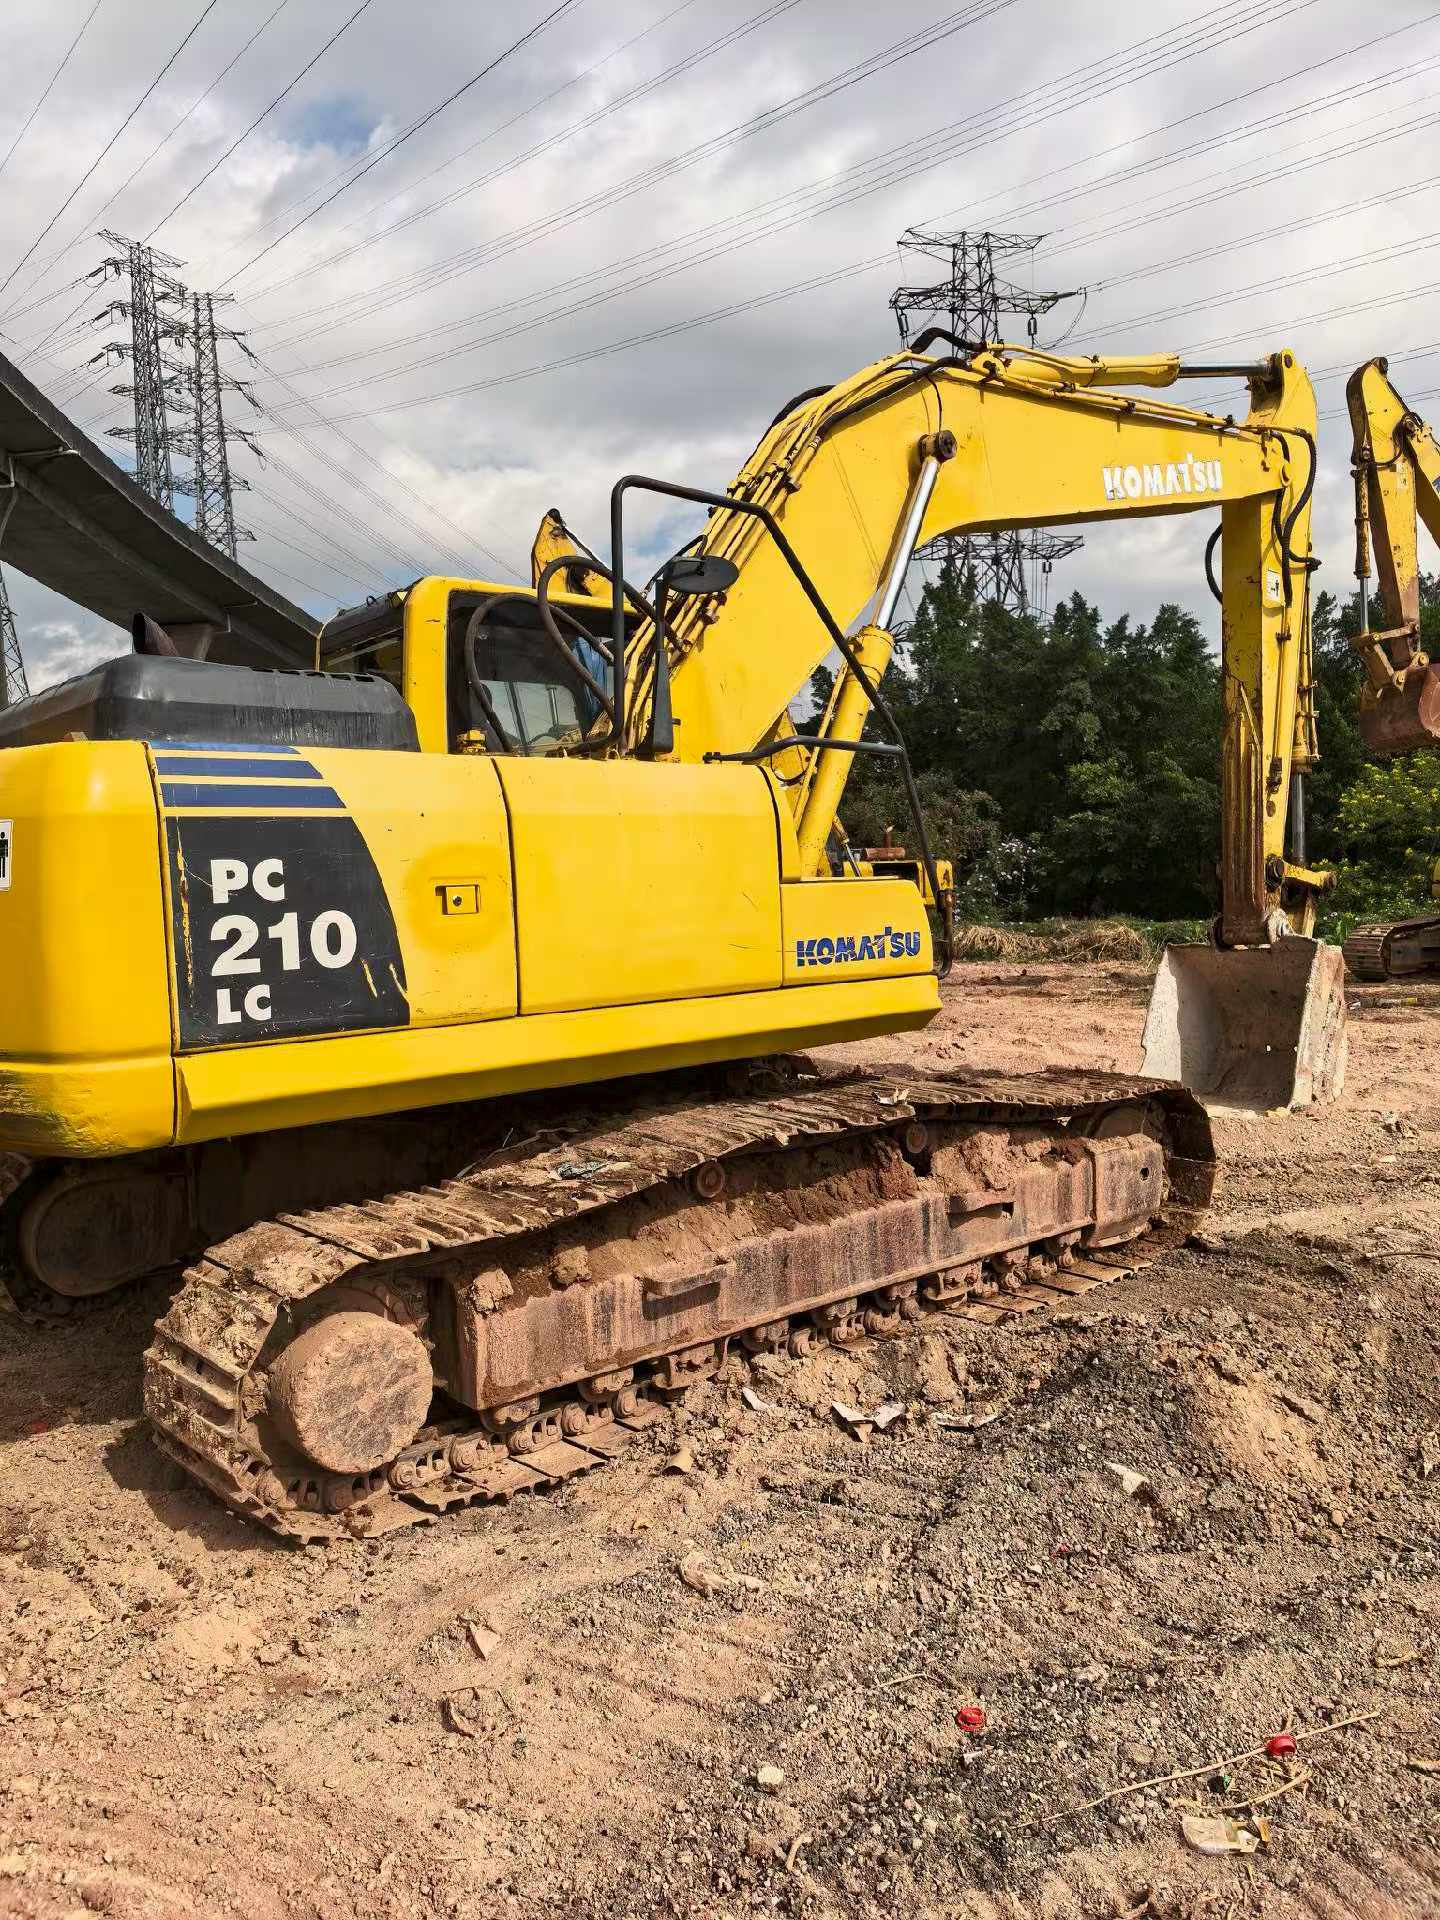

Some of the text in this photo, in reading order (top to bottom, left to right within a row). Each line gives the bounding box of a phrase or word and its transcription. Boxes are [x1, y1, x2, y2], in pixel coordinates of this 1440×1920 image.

[1103, 452, 1223, 500] KOMATSU
[210, 859, 286, 904] PC
[210, 909, 357, 977] 210
[796, 926, 921, 967] KOMATSU
[217, 984, 272, 1024] LC
